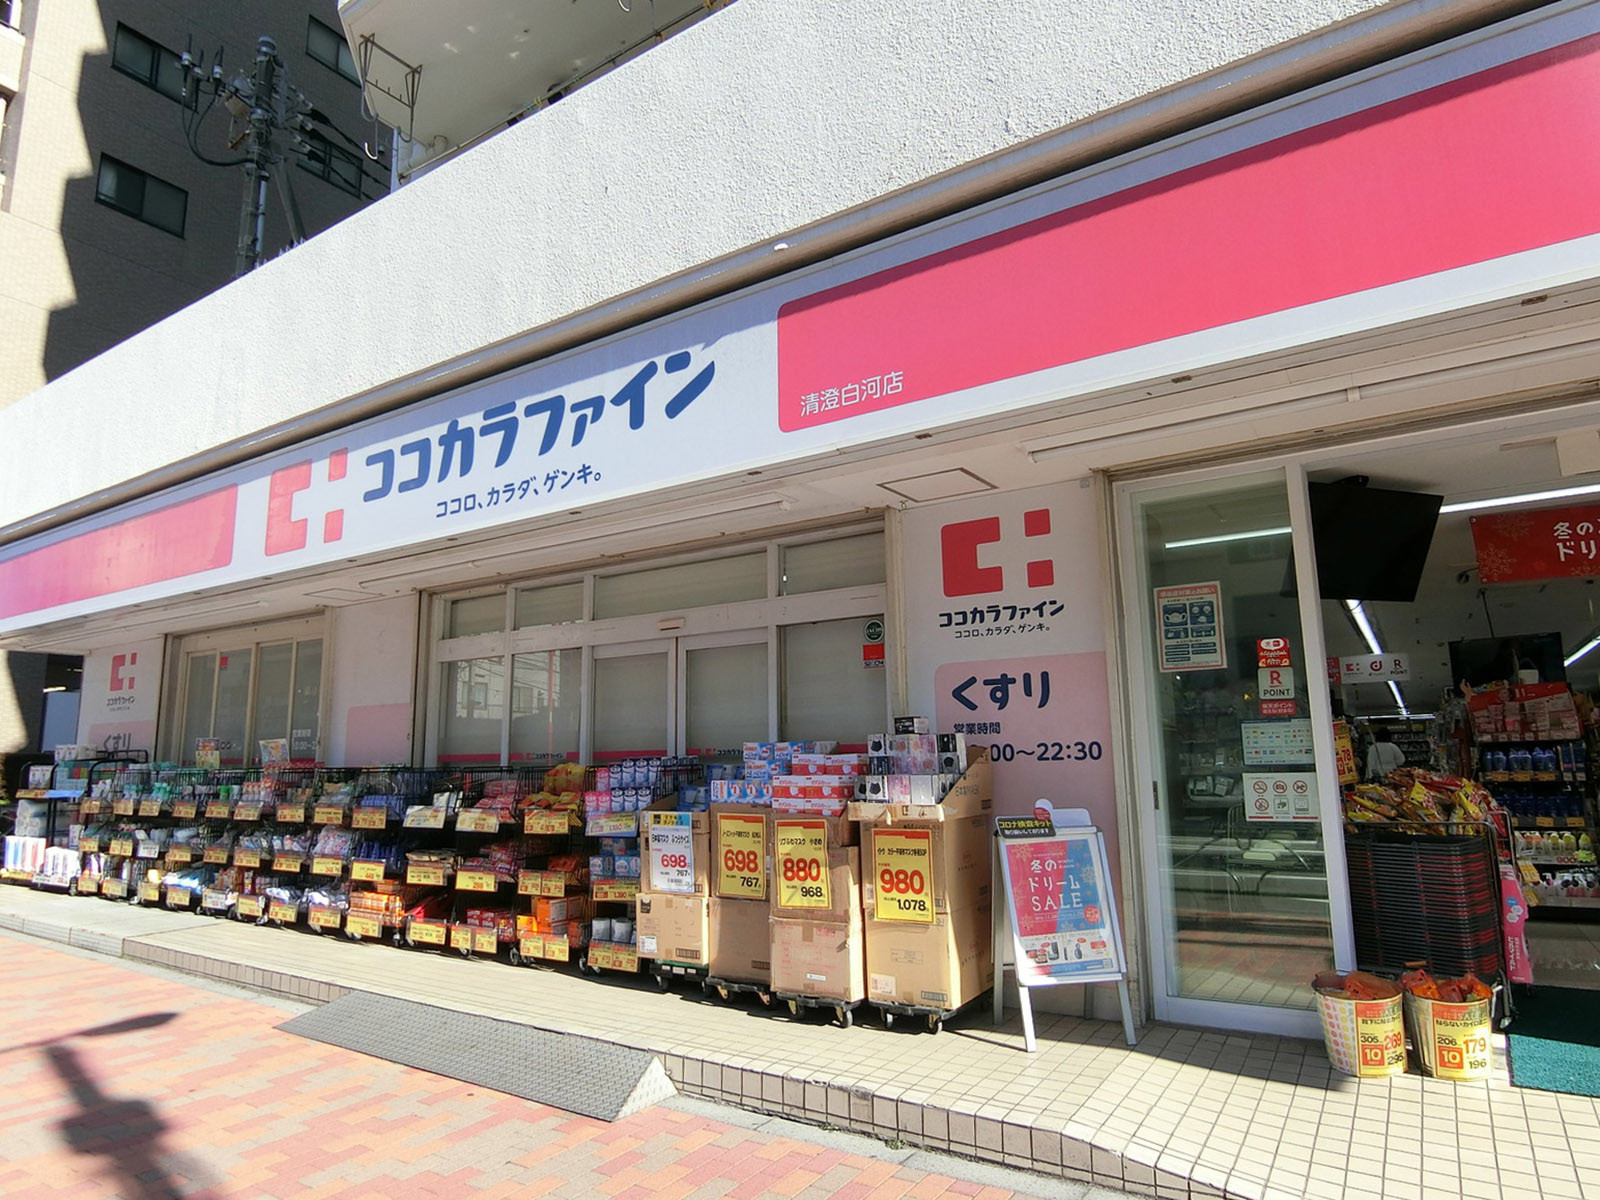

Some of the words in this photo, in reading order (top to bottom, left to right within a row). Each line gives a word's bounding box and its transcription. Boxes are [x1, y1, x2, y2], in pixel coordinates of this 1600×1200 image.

[800, 371, 904, 416] 清澄白河店
[363, 350, 715, 502] ココカラファイン
[435, 463, 602, 518] ココロ、カラダ、ゲンキ。
[939, 600, 1065, 628] ココカラファイン
[954, 623, 1051, 639] ココロ、カラダ、ゲンキ。
[1270, 670, 1283, 685] R
[952, 671, 1050, 711] くすり
[1263, 688, 1291, 697] POINT
[953, 721, 1000, 735] 営業時間
[989, 741, 1103, 763] 00～22:30
[661, 853, 687, 868] 698
[724, 849, 758, 873] 698
[1031, 859, 1057, 873] 冬の
[783, 857, 821, 882] 880
[740, 876, 760, 888] 767
[880, 868, 925, 895] 980
[1028, 875, 1080, 893] ドリーム
[800, 886, 823, 897] 968
[1031, 893, 1083, 911] SALE
[1437, 1037, 1457, 1046] 206
[1463, 1037, 1486, 1054] 179
[1364, 1048, 1381, 1060] 10
[1441, 1050, 1461, 1063] 10
[1469, 1058, 1487, 1069] 196
